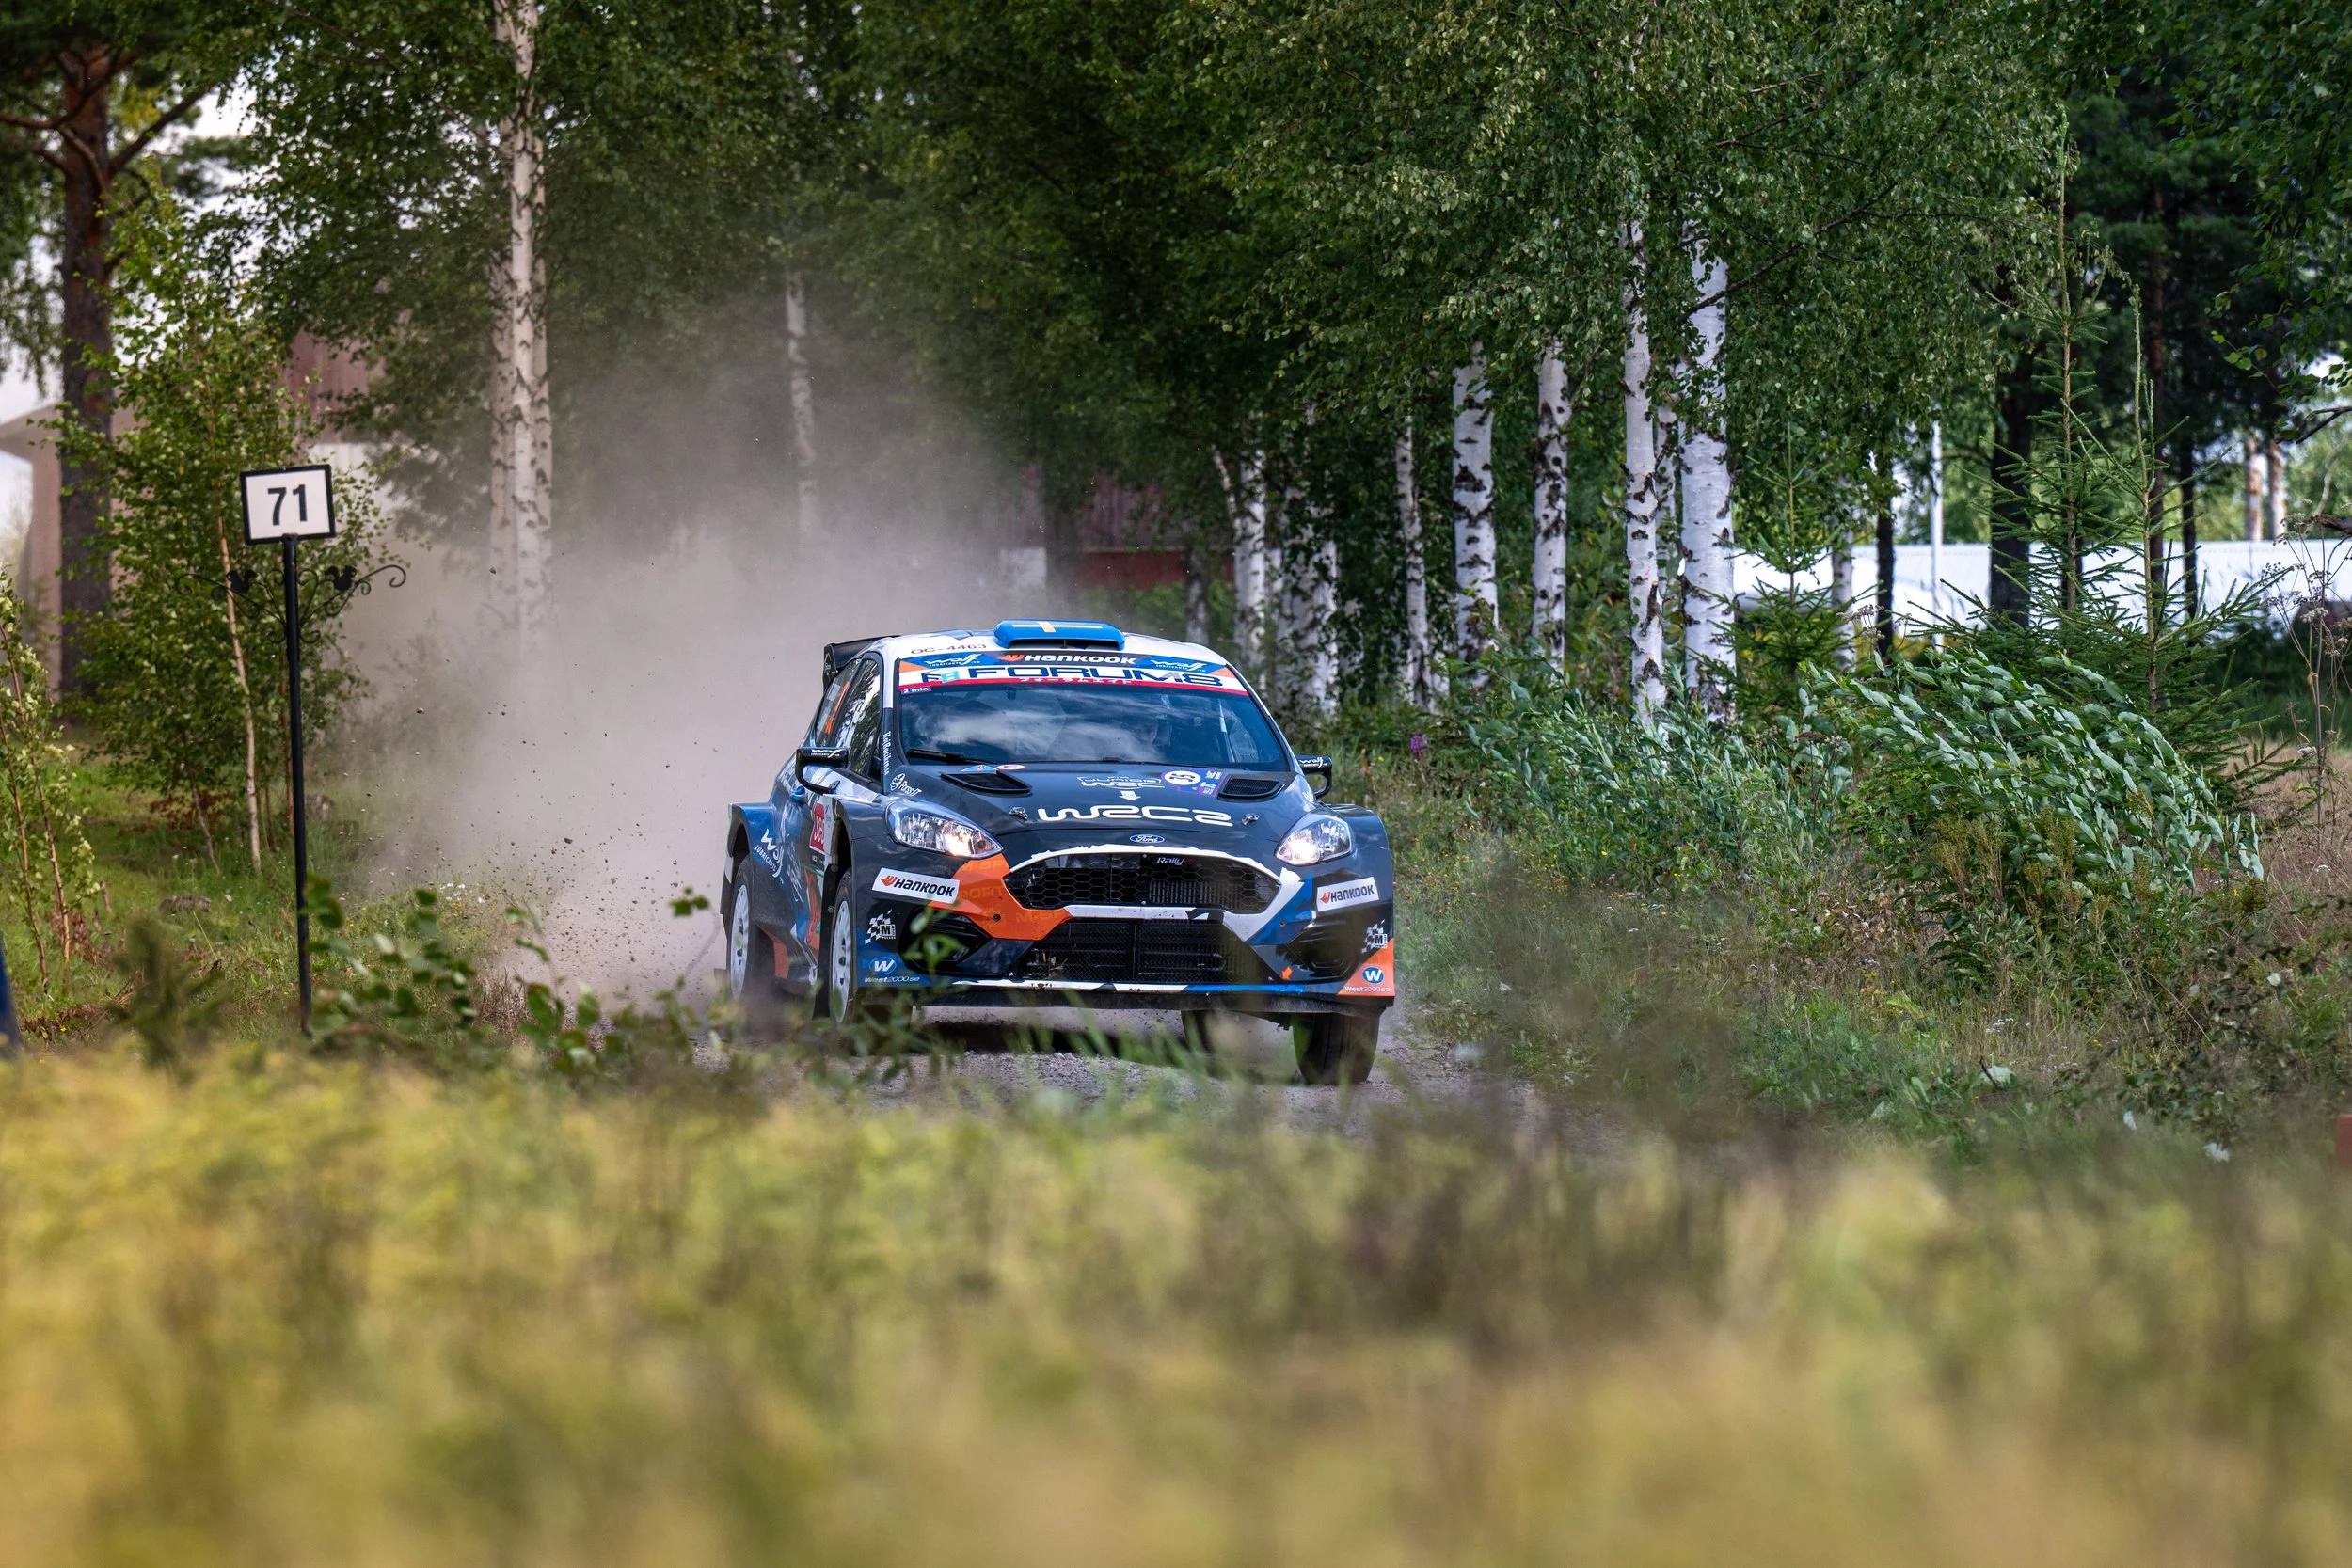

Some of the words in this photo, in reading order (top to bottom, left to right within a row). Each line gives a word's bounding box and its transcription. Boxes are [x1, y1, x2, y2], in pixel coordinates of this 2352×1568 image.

[267, 483, 308, 526] 71
[968, 667, 1224, 687] FORUM8
[1037, 804, 1233, 827] WRC2
[755, 845, 777, 872] LUBRICANTS
[874, 959, 895, 972] W
[1365, 970, 1382, 982] W
